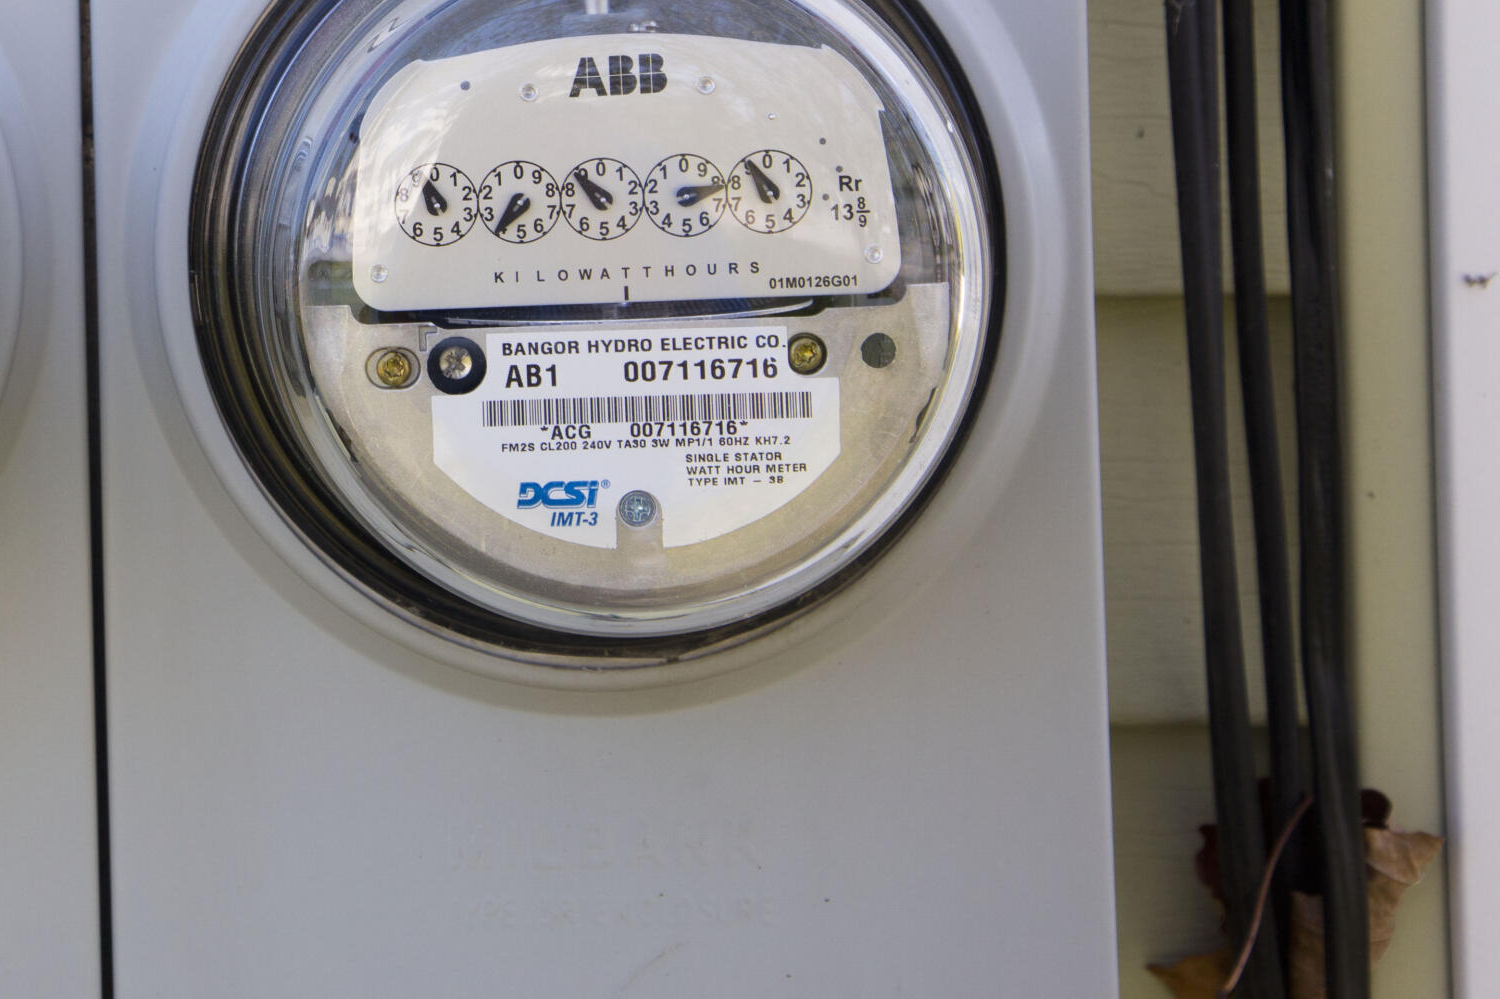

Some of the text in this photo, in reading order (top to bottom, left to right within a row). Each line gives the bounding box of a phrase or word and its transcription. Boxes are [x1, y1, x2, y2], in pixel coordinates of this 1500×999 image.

[569, 53, 668, 98] ABB
[838, 175, 863, 192] Rr
[769, 274, 859, 290] 01M0126G01
[501, 334, 786, 356] BANGOR HYDRO ELECTRIC CO.
[505, 358, 777, 388] AB1 007116716
[501, 435, 790, 452] FM2S CL200 240V TA30 3W MP1/1 60HZ KH7.2
[685, 451, 782, 463] SINGLE STATOR
[685, 462, 806, 475] WATT HOUR METER
[687, 477, 718, 486] TYPE
[723, 476, 745, 485] IMT
[768, 475, 784, 484] 3B
[550, 511, 598, 527] IMT-3
